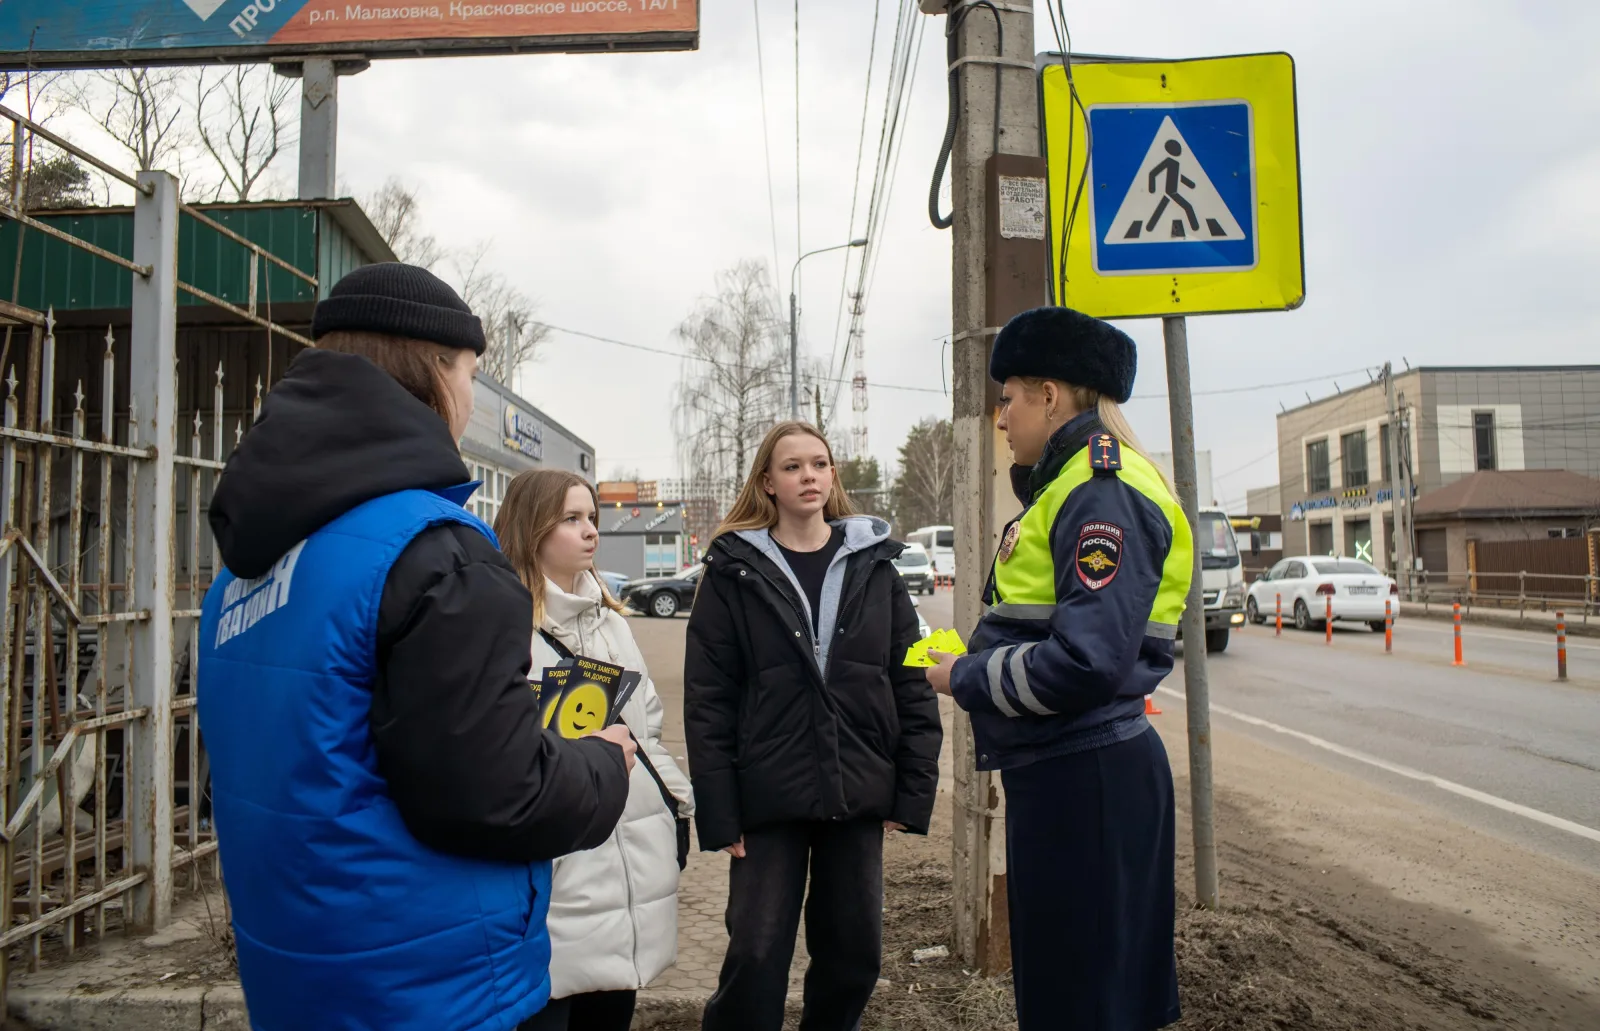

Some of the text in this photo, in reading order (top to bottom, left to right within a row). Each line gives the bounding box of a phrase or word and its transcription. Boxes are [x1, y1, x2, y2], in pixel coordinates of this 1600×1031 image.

[228, 0, 282, 39] ПРО
[309, 9, 340, 25] р.п.
[345, 4, 444, 21] Малаховка,
[449, 1, 565, 20] Красковское
[571, 0, 632, 14] шоссе,
[1083, 524, 1120, 537] ПОЛИЦИЯ
[1082, 538, 1117, 552] РОССИЯ
[1086, 577, 1102, 590] МВД
[577, 659, 620, 677] БУДЬТЕ ЗАМЕТНЫ
[583, 671, 612, 684] НА ДОРОГЕ
